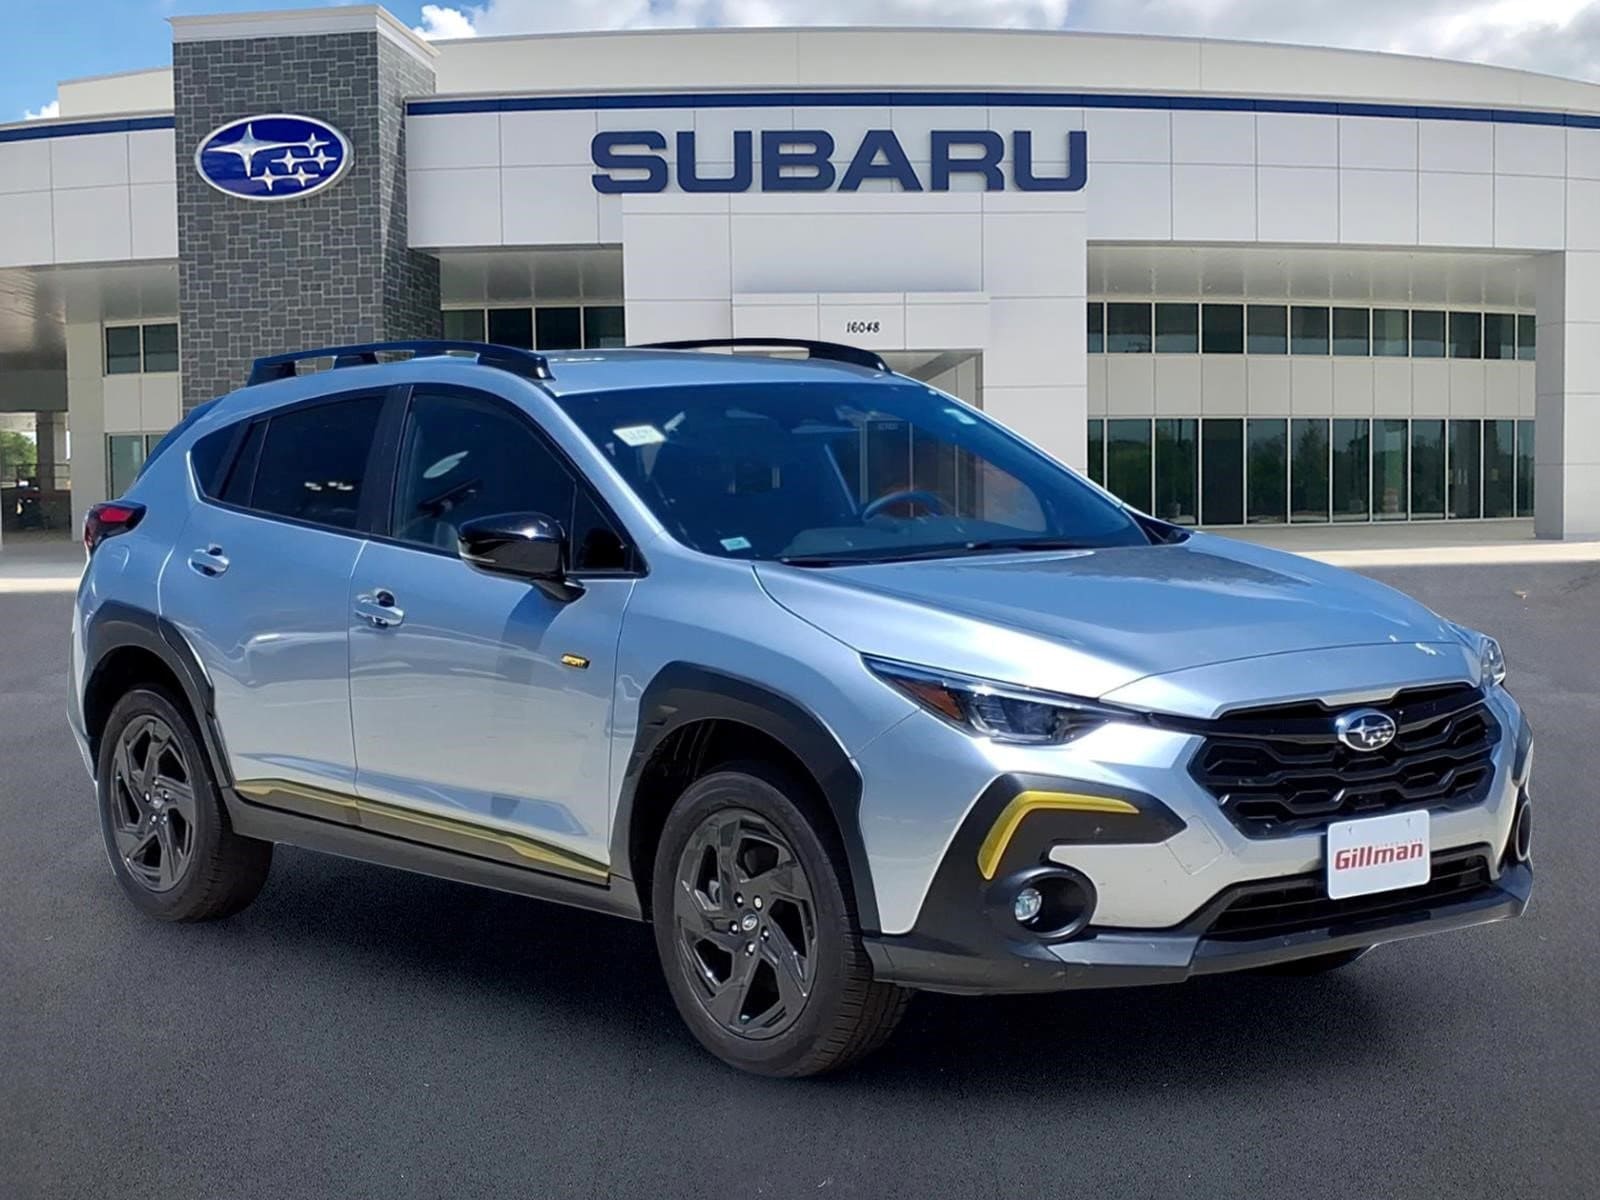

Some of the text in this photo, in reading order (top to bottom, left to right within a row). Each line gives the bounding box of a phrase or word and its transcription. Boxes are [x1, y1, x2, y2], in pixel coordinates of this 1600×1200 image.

[591, 130, 1087, 193] SUBARU
[846, 321, 880, 333] 16048
[1335, 843, 1424, 870] Gillman
